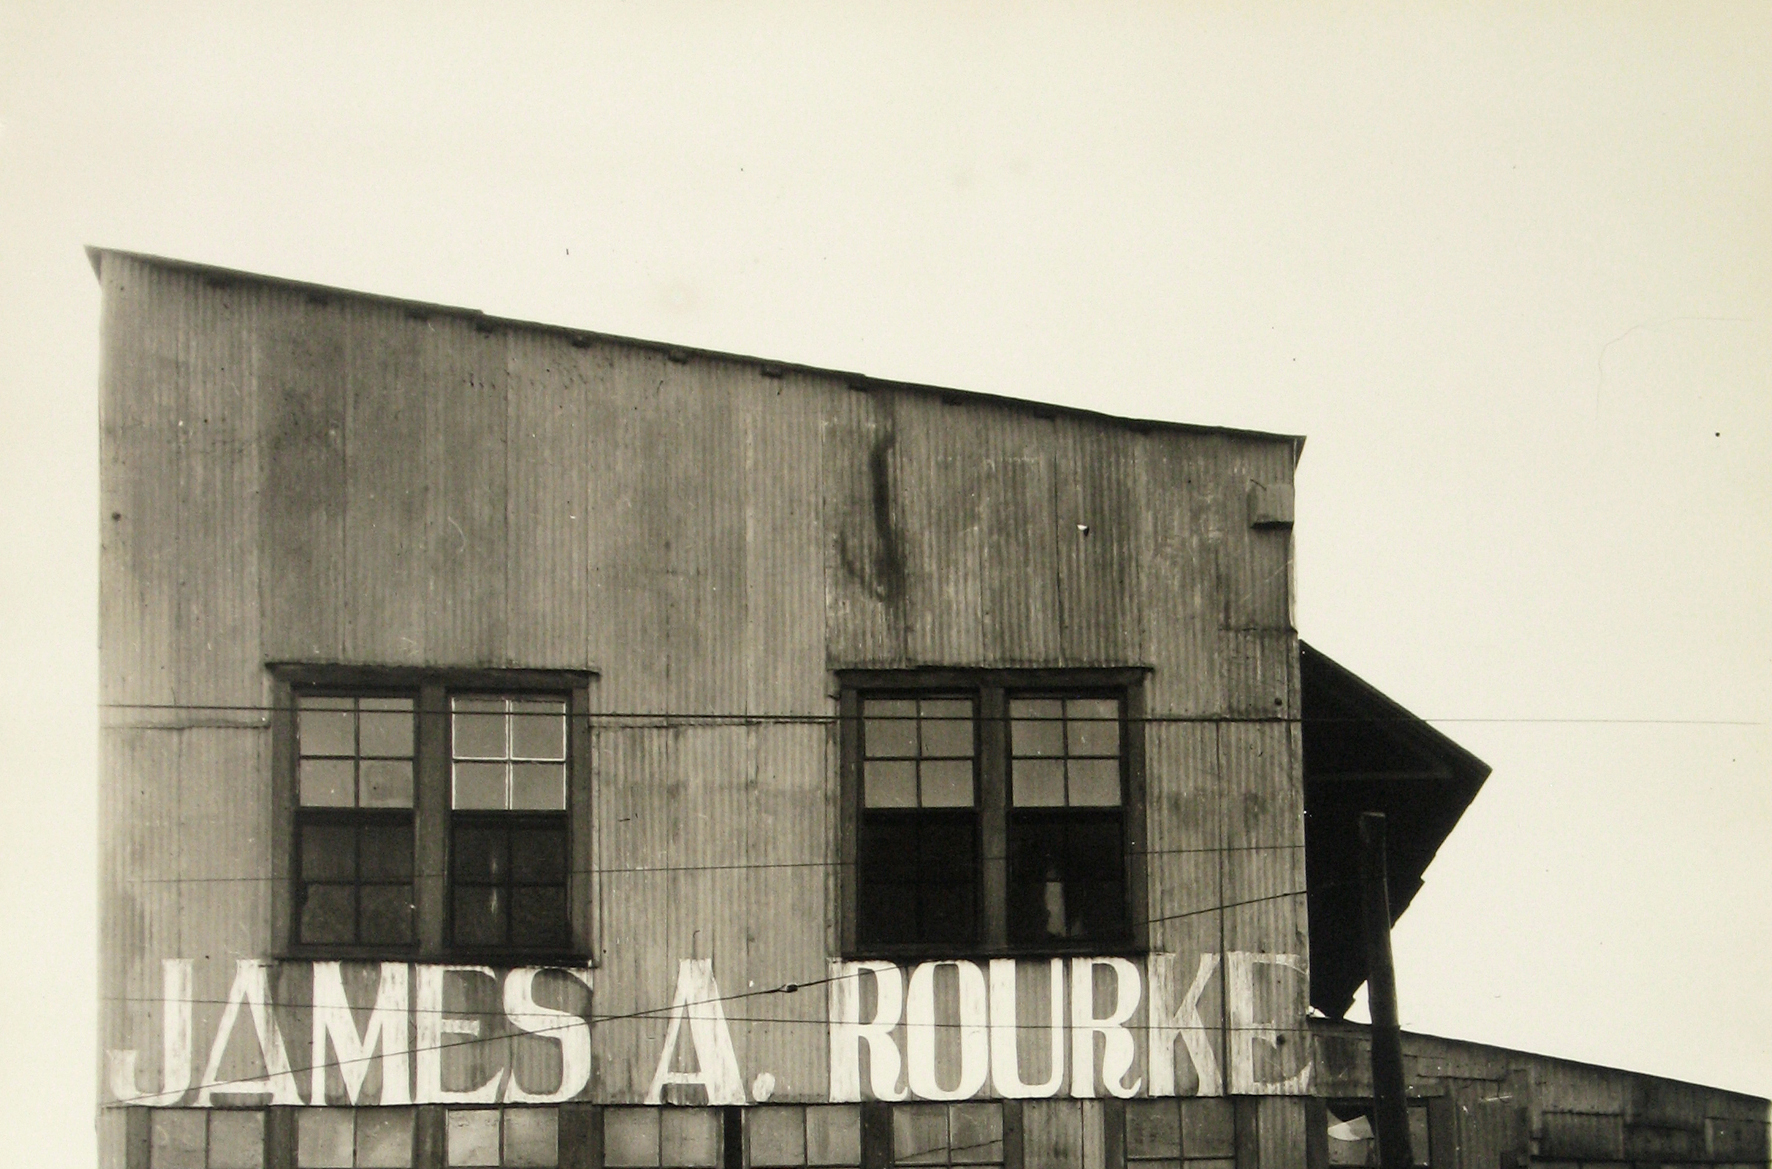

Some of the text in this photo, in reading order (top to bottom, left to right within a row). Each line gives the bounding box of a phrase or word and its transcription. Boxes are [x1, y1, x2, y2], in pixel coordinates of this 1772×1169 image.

[108, 950, 1312, 1106] JAMES A. ROURKE
